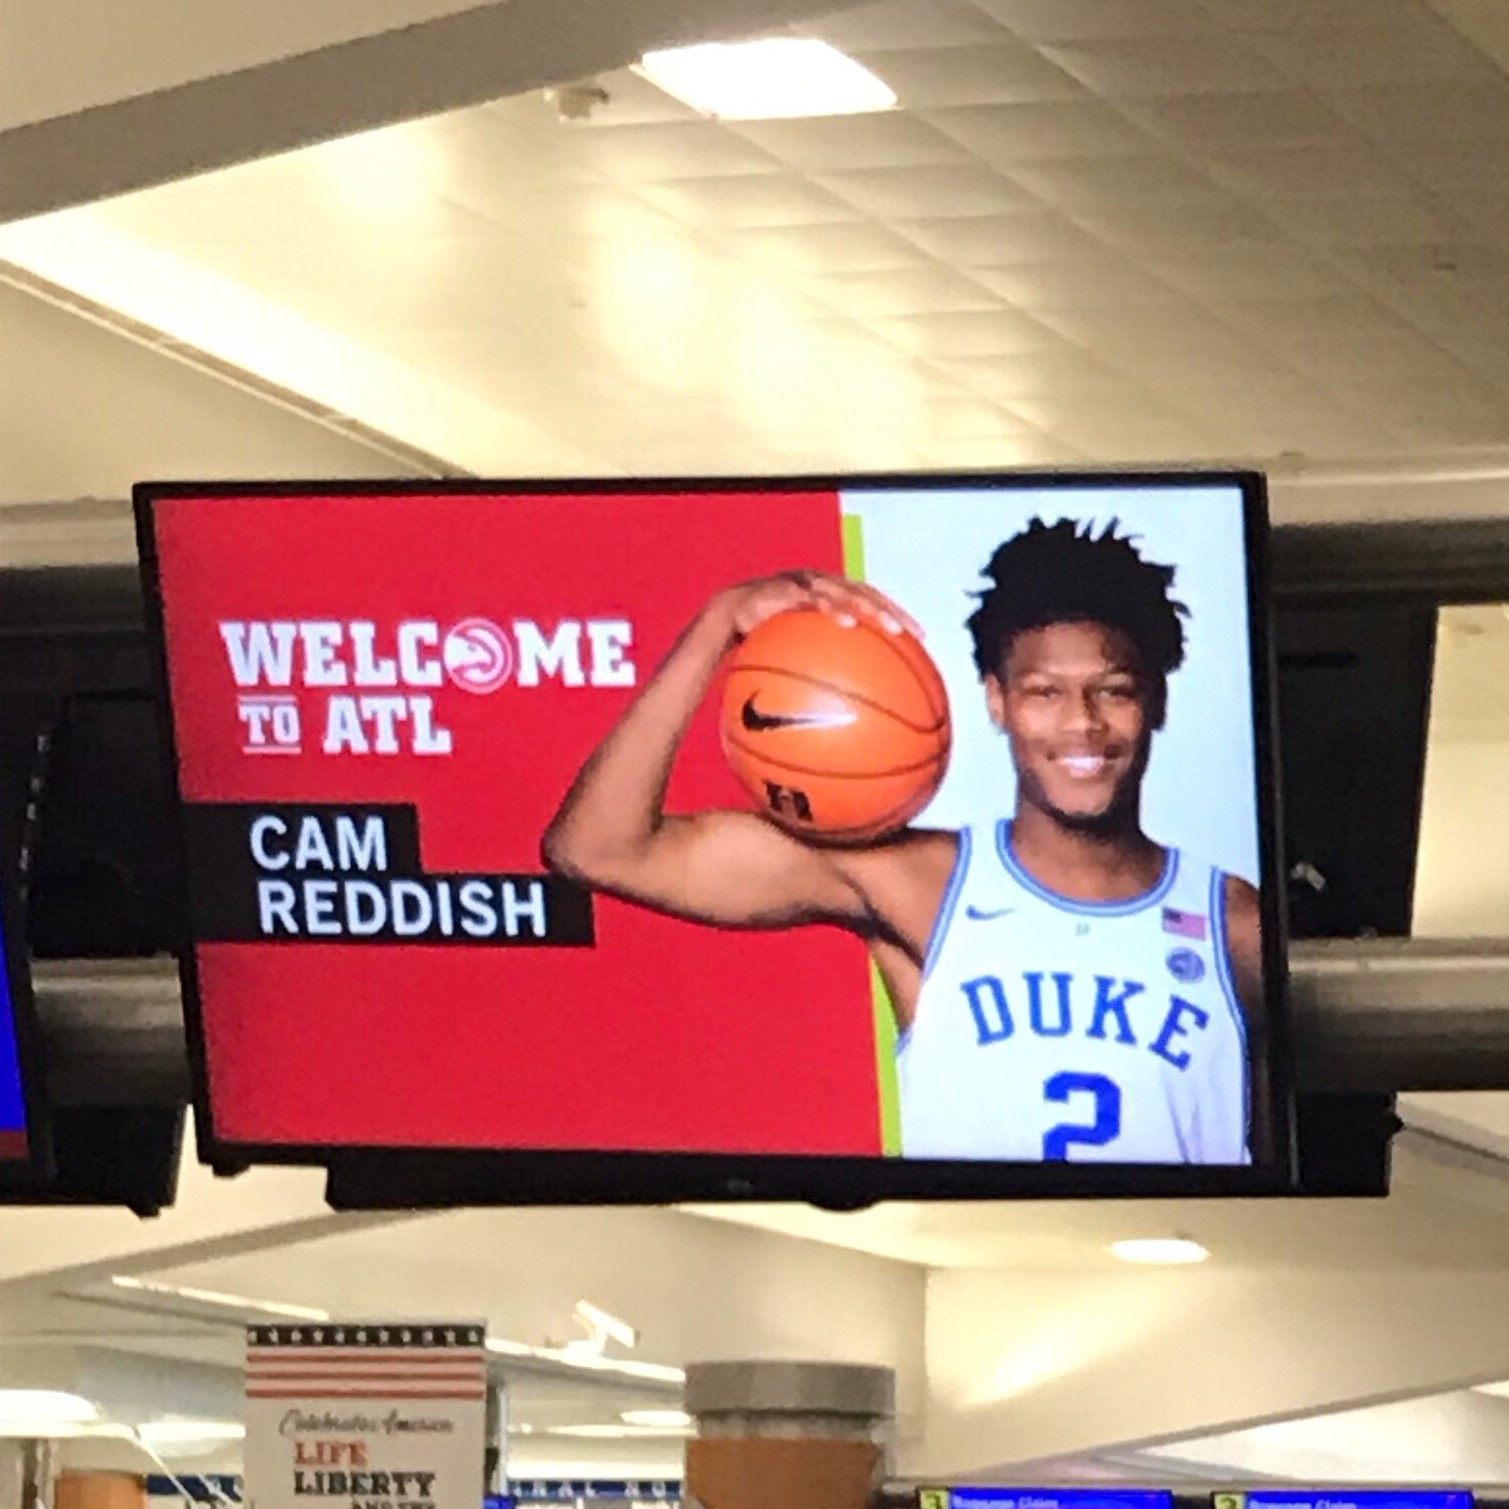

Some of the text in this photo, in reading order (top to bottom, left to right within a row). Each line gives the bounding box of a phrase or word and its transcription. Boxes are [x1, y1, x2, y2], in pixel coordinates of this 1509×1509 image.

[218, 618, 637, 693] WELCOME
[238, 695, 453, 755] TO ATL
[249, 814, 388, 872] CAM
[258, 880, 547, 937] REDDISH
[960, 970, 1209, 1070] DUKE
[1042, 1070, 1122, 1162] 2
[294, 1439, 369, 1466] LIFE
[293, 1470, 436, 1497] LIBERTY
